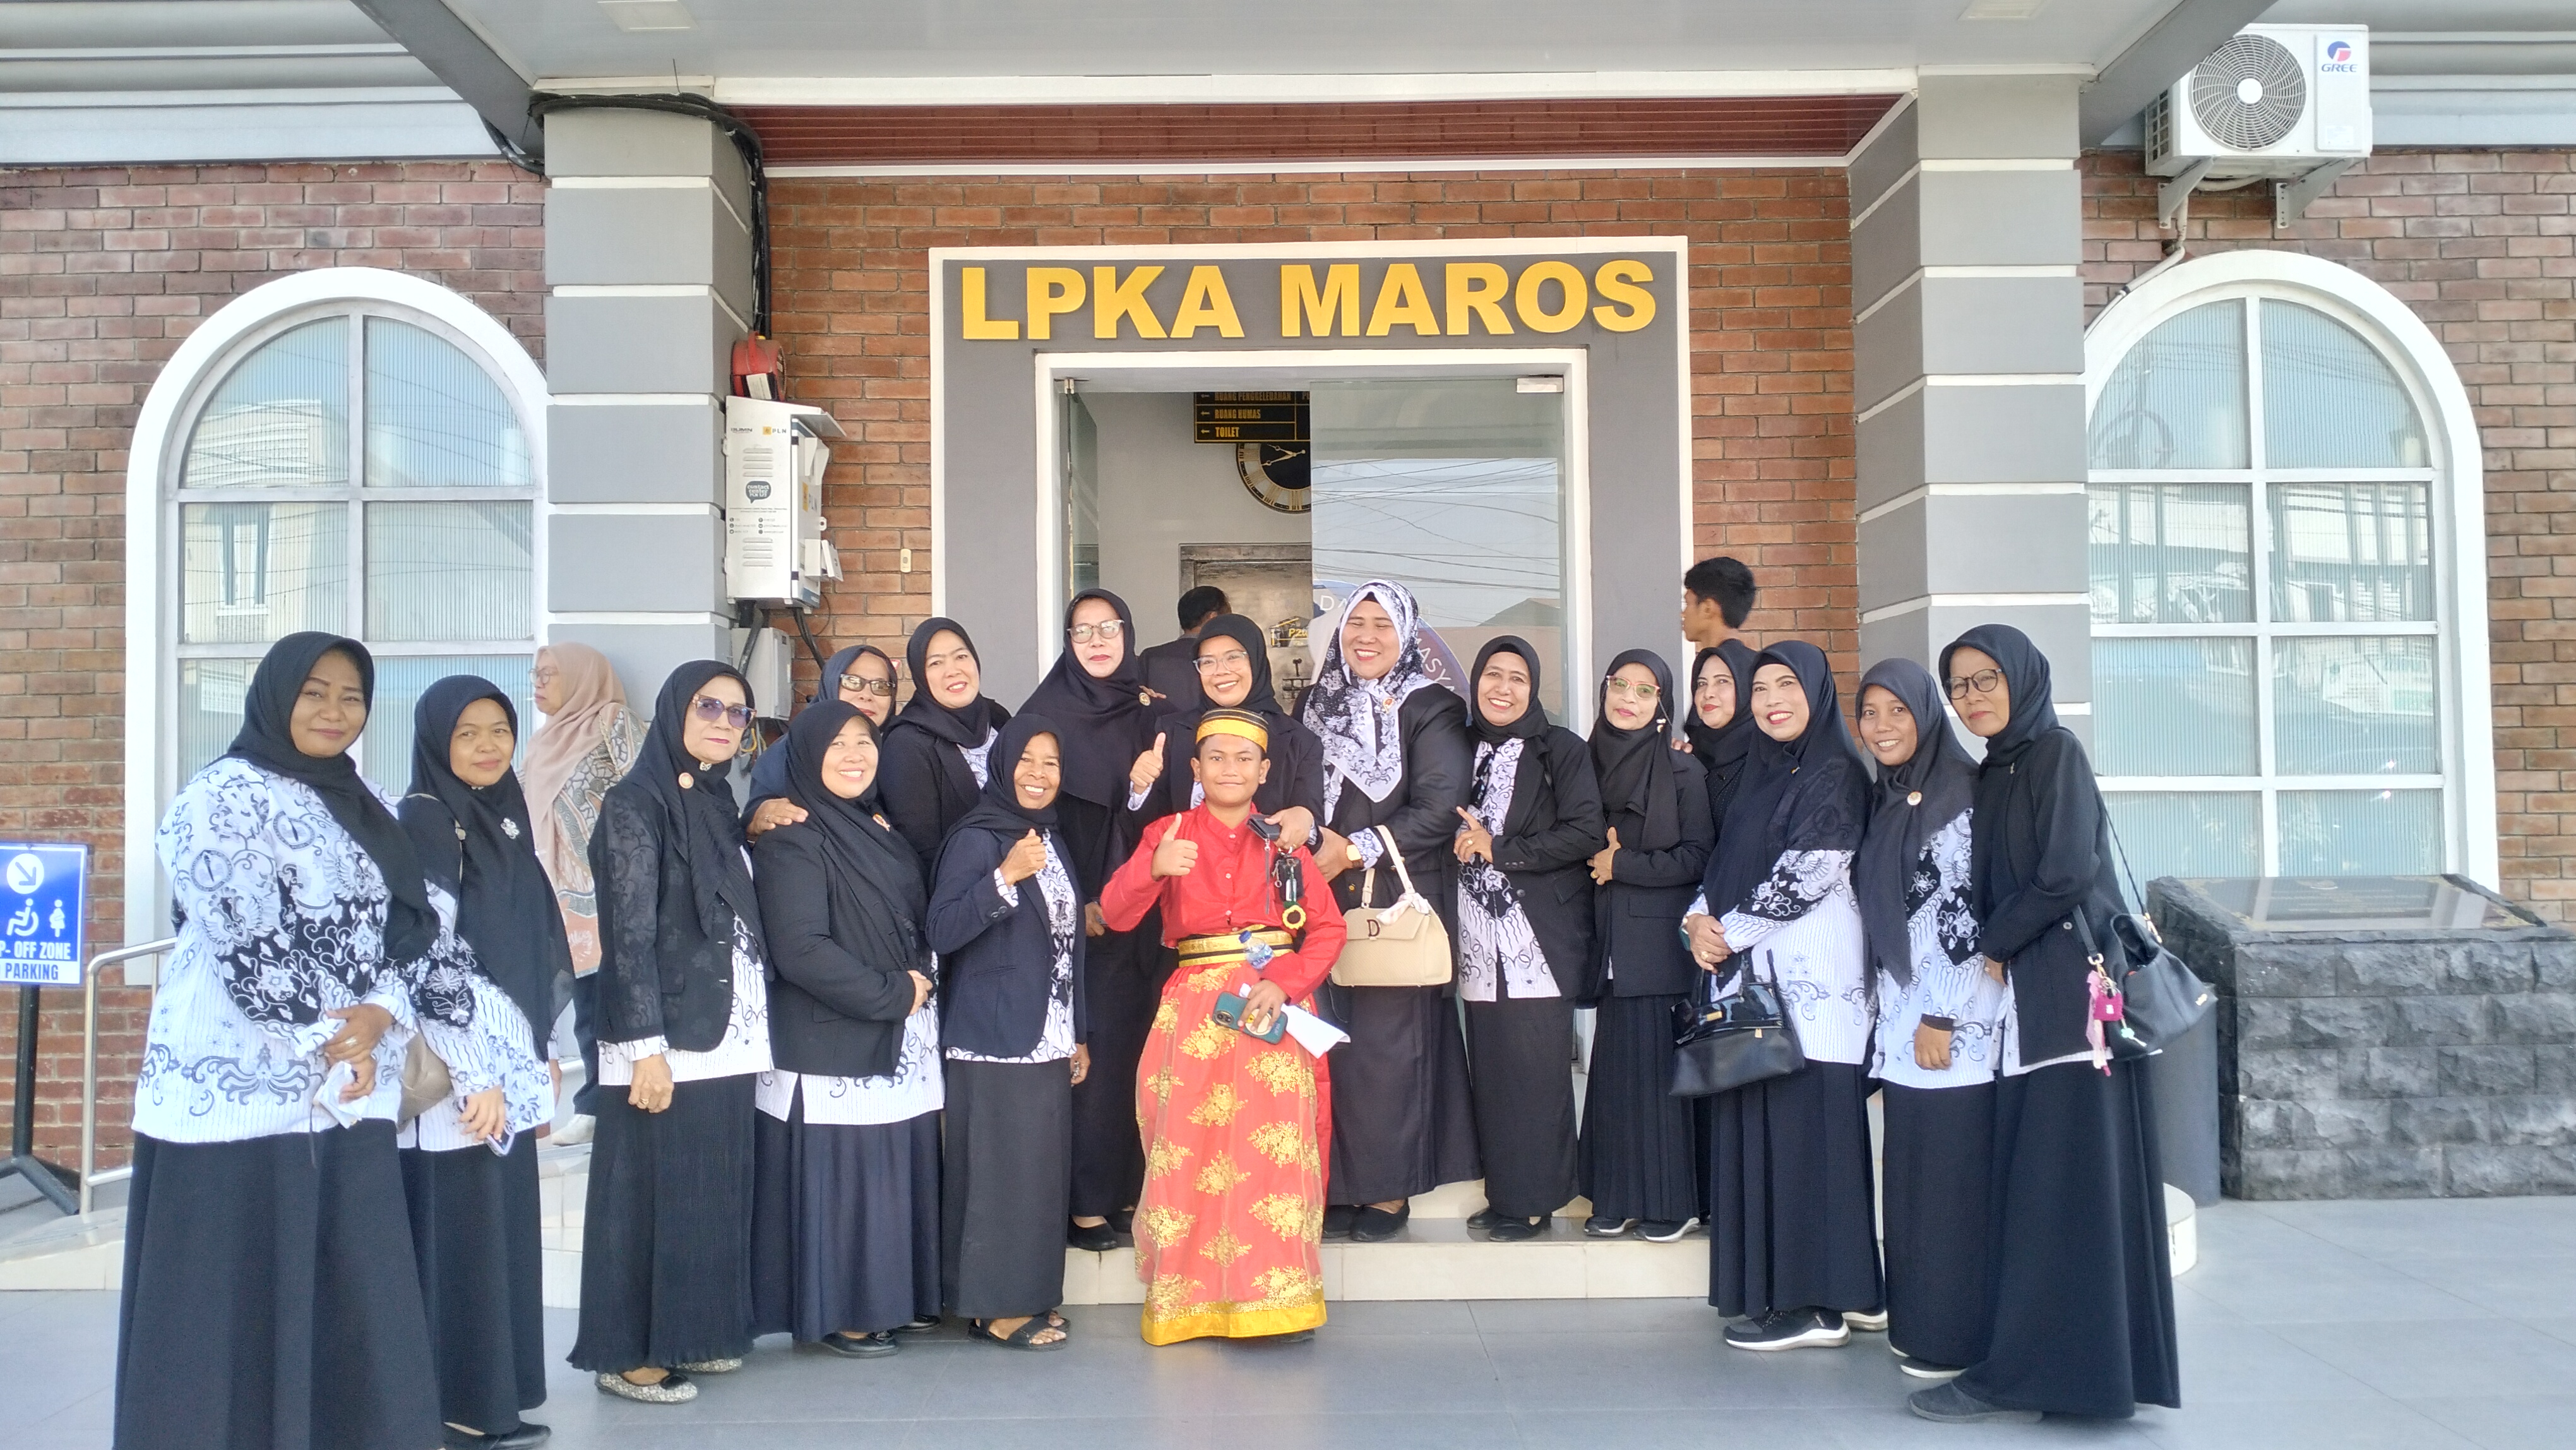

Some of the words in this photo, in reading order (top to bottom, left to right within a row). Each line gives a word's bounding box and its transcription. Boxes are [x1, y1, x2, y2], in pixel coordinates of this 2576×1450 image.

[2321, 63, 2358, 73] GREE
[962, 265, 1245, 341] LPKA
[1280, 260, 1657, 337] MAROS
[1215, 409, 1237, 419] RUANG
[1215, 427, 1239, 437] TOILET
[14, 941, 37, 958] OFF
[39, 942, 71, 960] ZONE
[5, 962, 59, 980] PARKING
